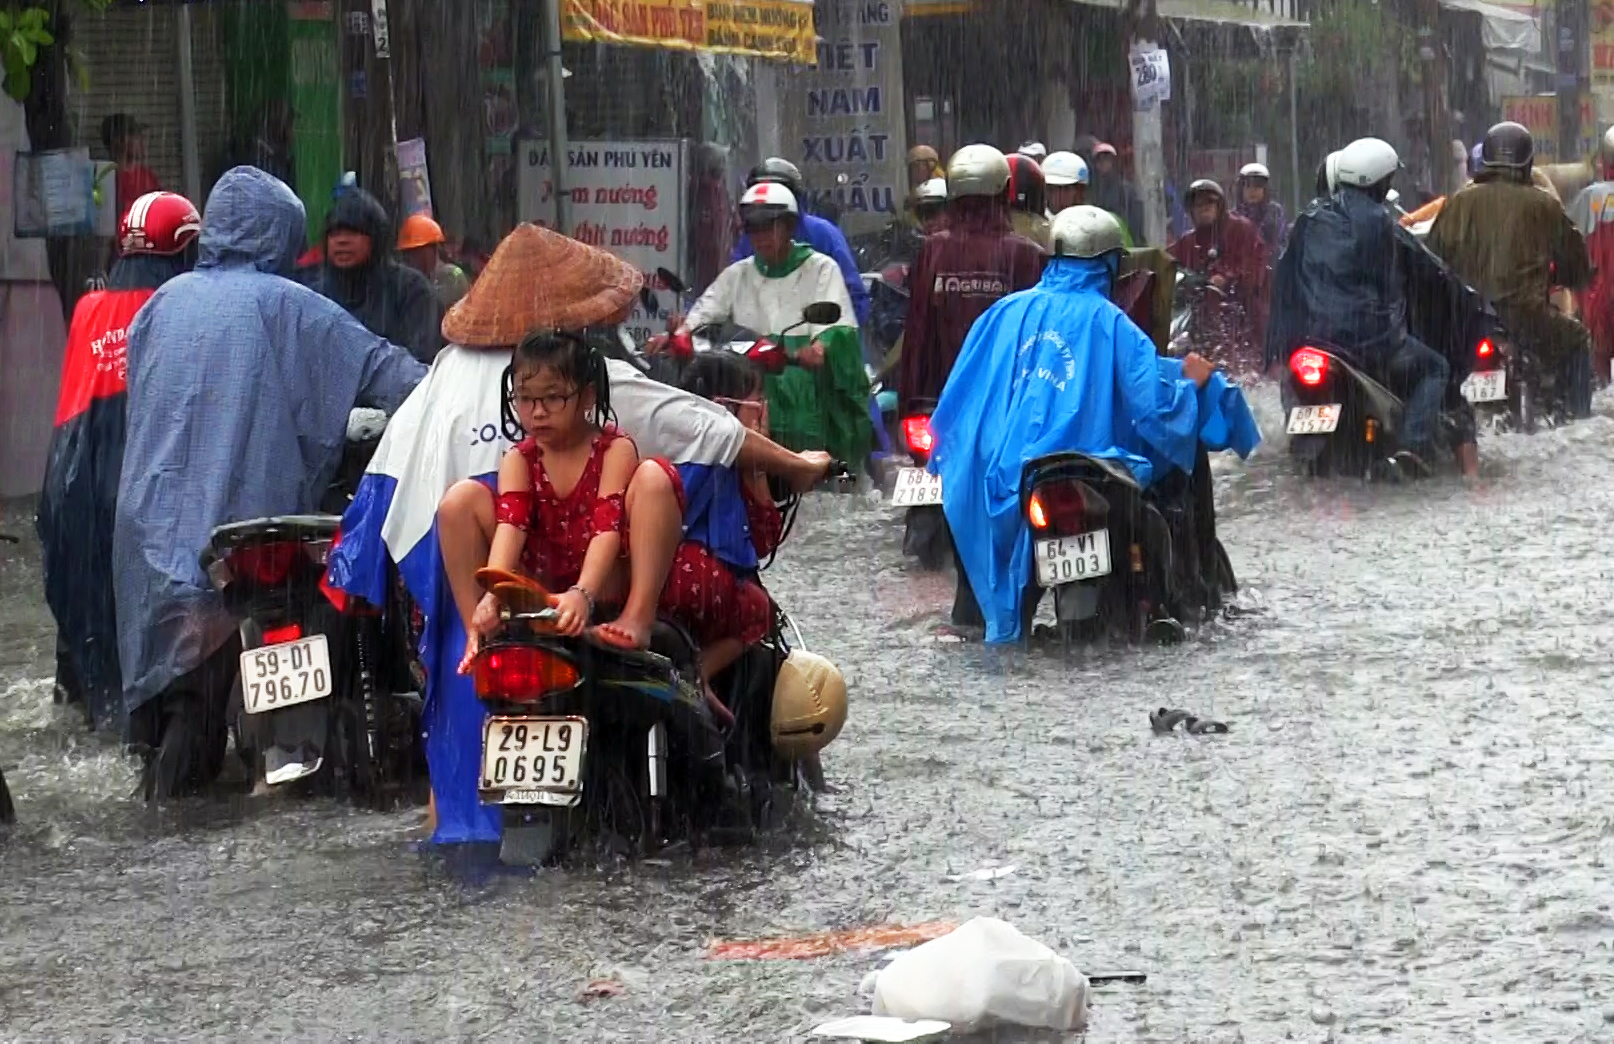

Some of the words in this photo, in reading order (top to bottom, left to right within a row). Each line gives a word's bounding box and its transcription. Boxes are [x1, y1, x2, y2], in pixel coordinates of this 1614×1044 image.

[808, 87, 880, 116] NAM
[1047, 534, 1096, 559] 64-V1
[1048, 554, 1100, 580] 3003
[255, 643, 313, 678] 59-D1
[249, 668, 326, 708] 796.70
[498, 724, 572, 752] 29-L9
[494, 755, 566, 784] 0695
